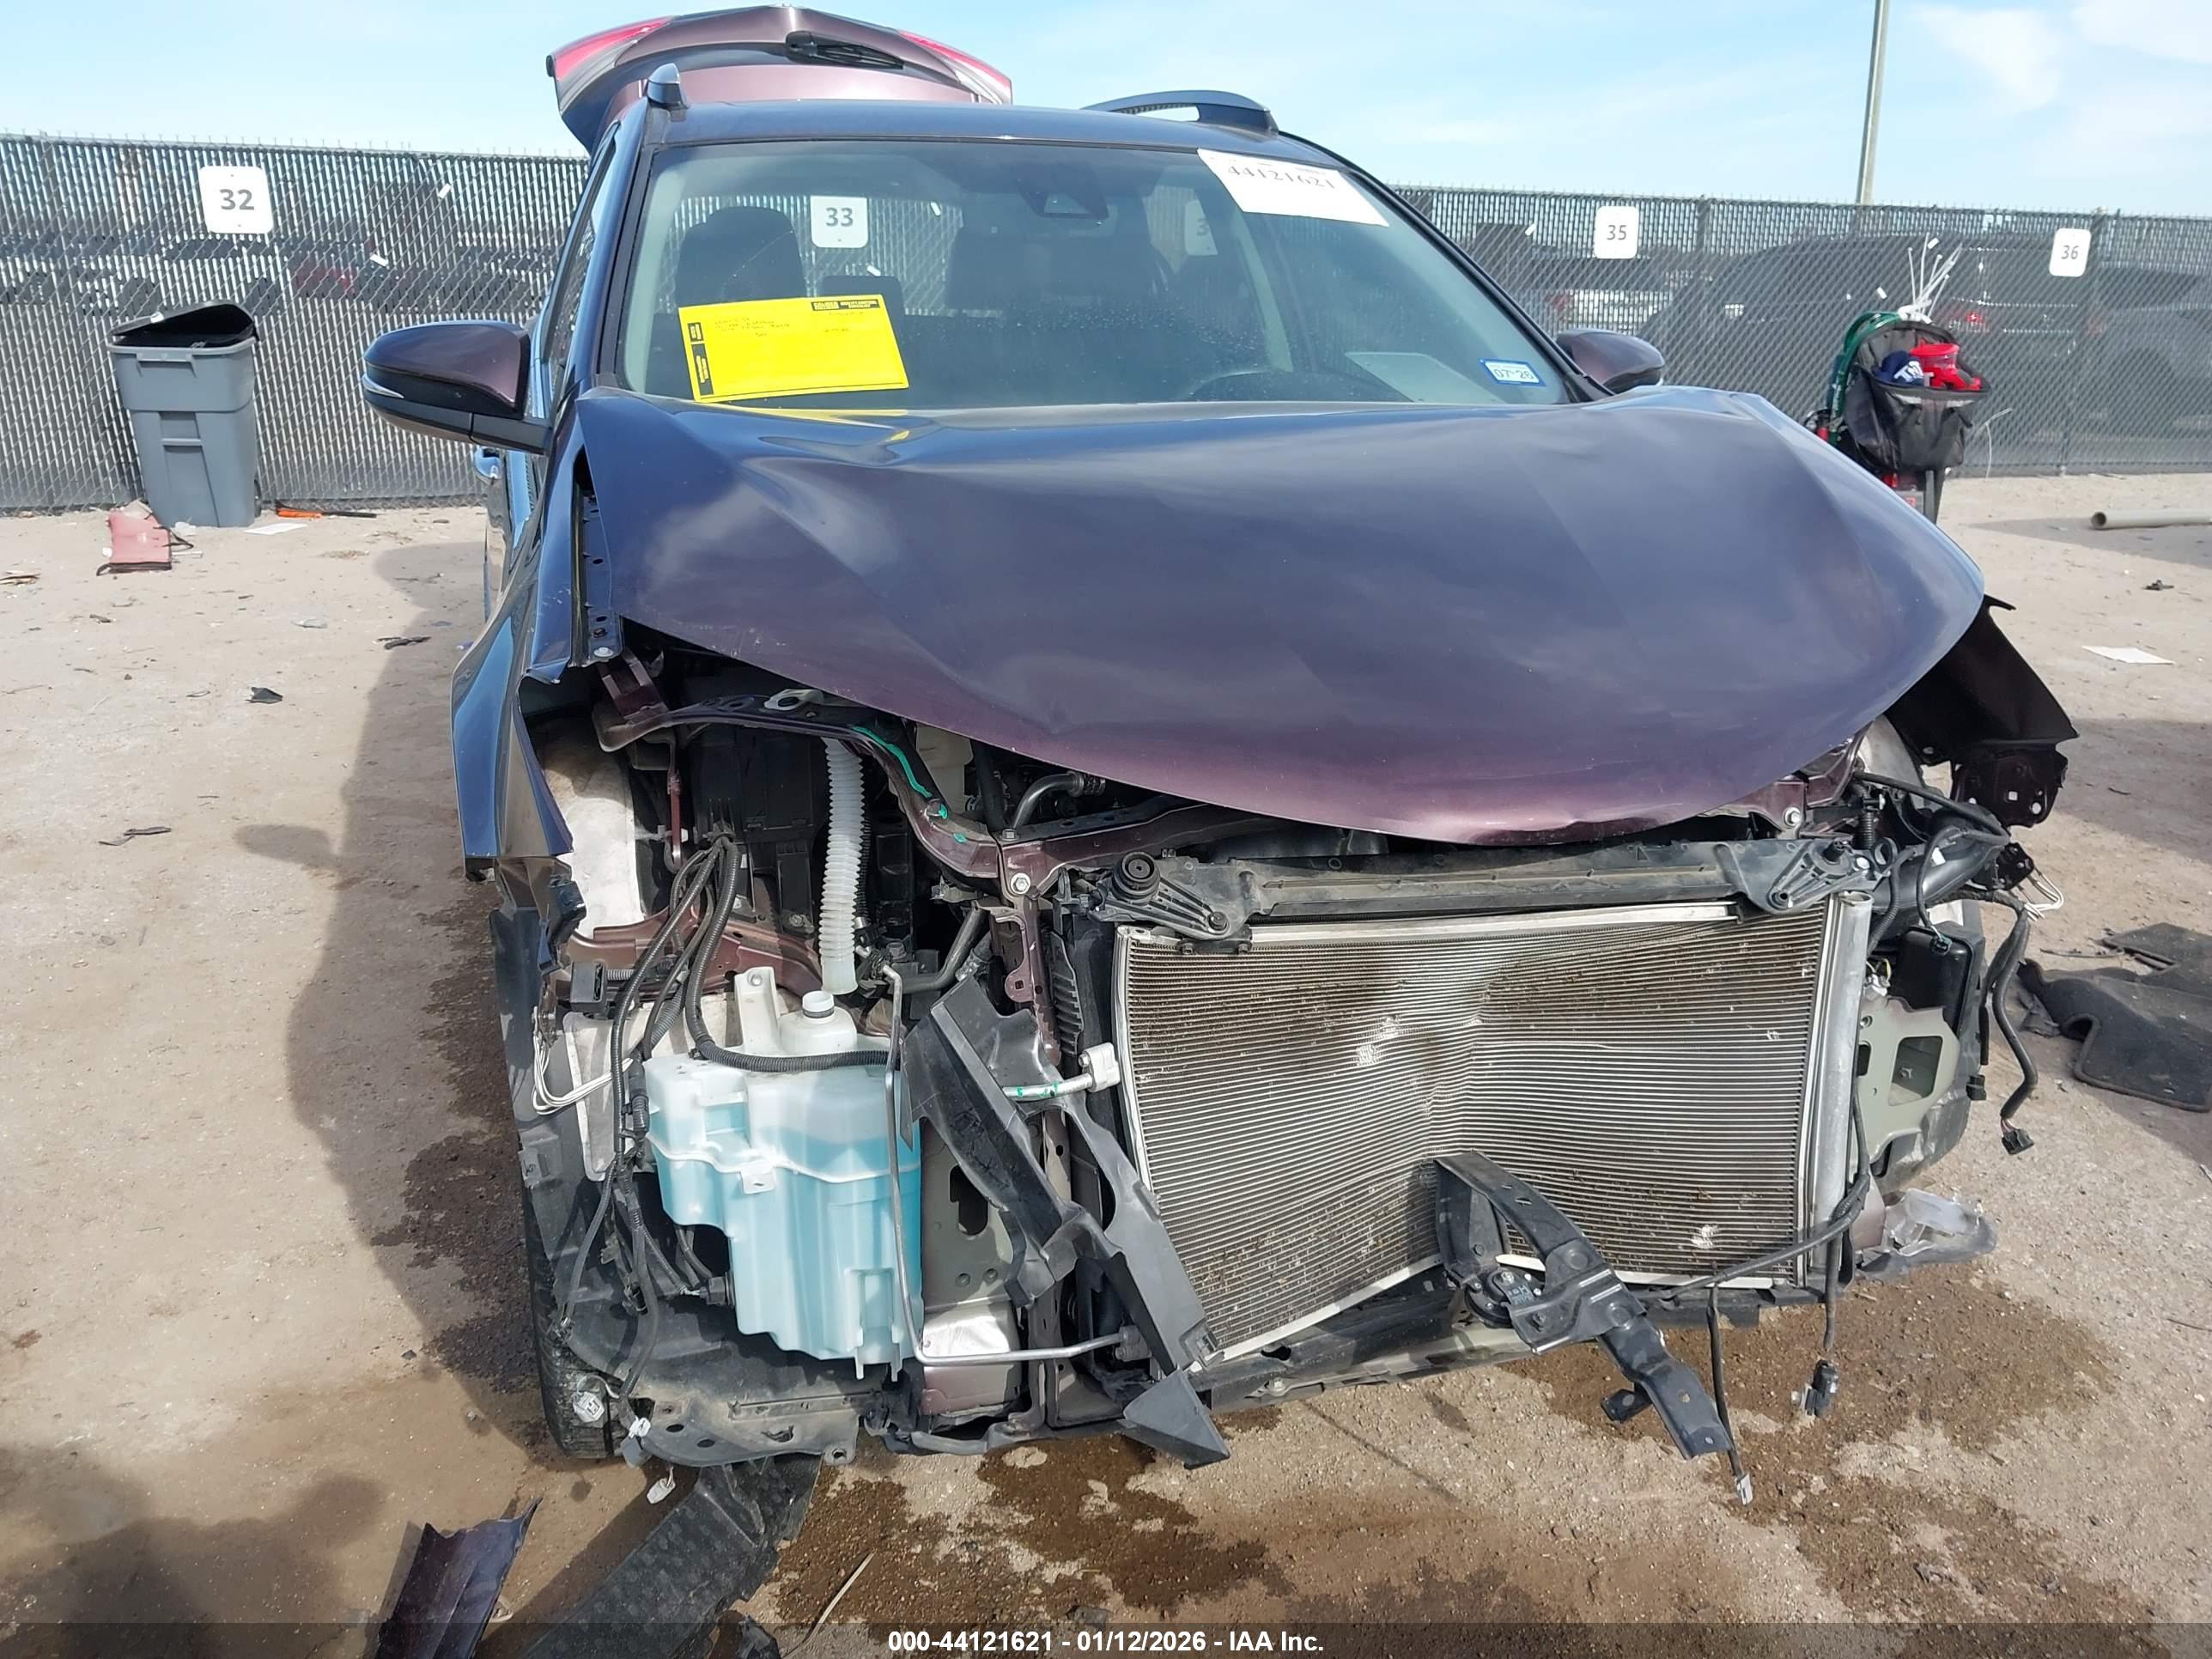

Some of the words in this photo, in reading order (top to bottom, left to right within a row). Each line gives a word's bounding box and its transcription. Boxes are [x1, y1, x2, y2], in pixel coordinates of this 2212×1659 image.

[1228, 166, 1335, 189] 44121621
[220, 189, 255, 210] 32
[826, 207, 854, 228] 33
[1196, 218, 1208, 236] 3
[1607, 225, 1628, 240] 35
[2061, 245, 2079, 259] 36
